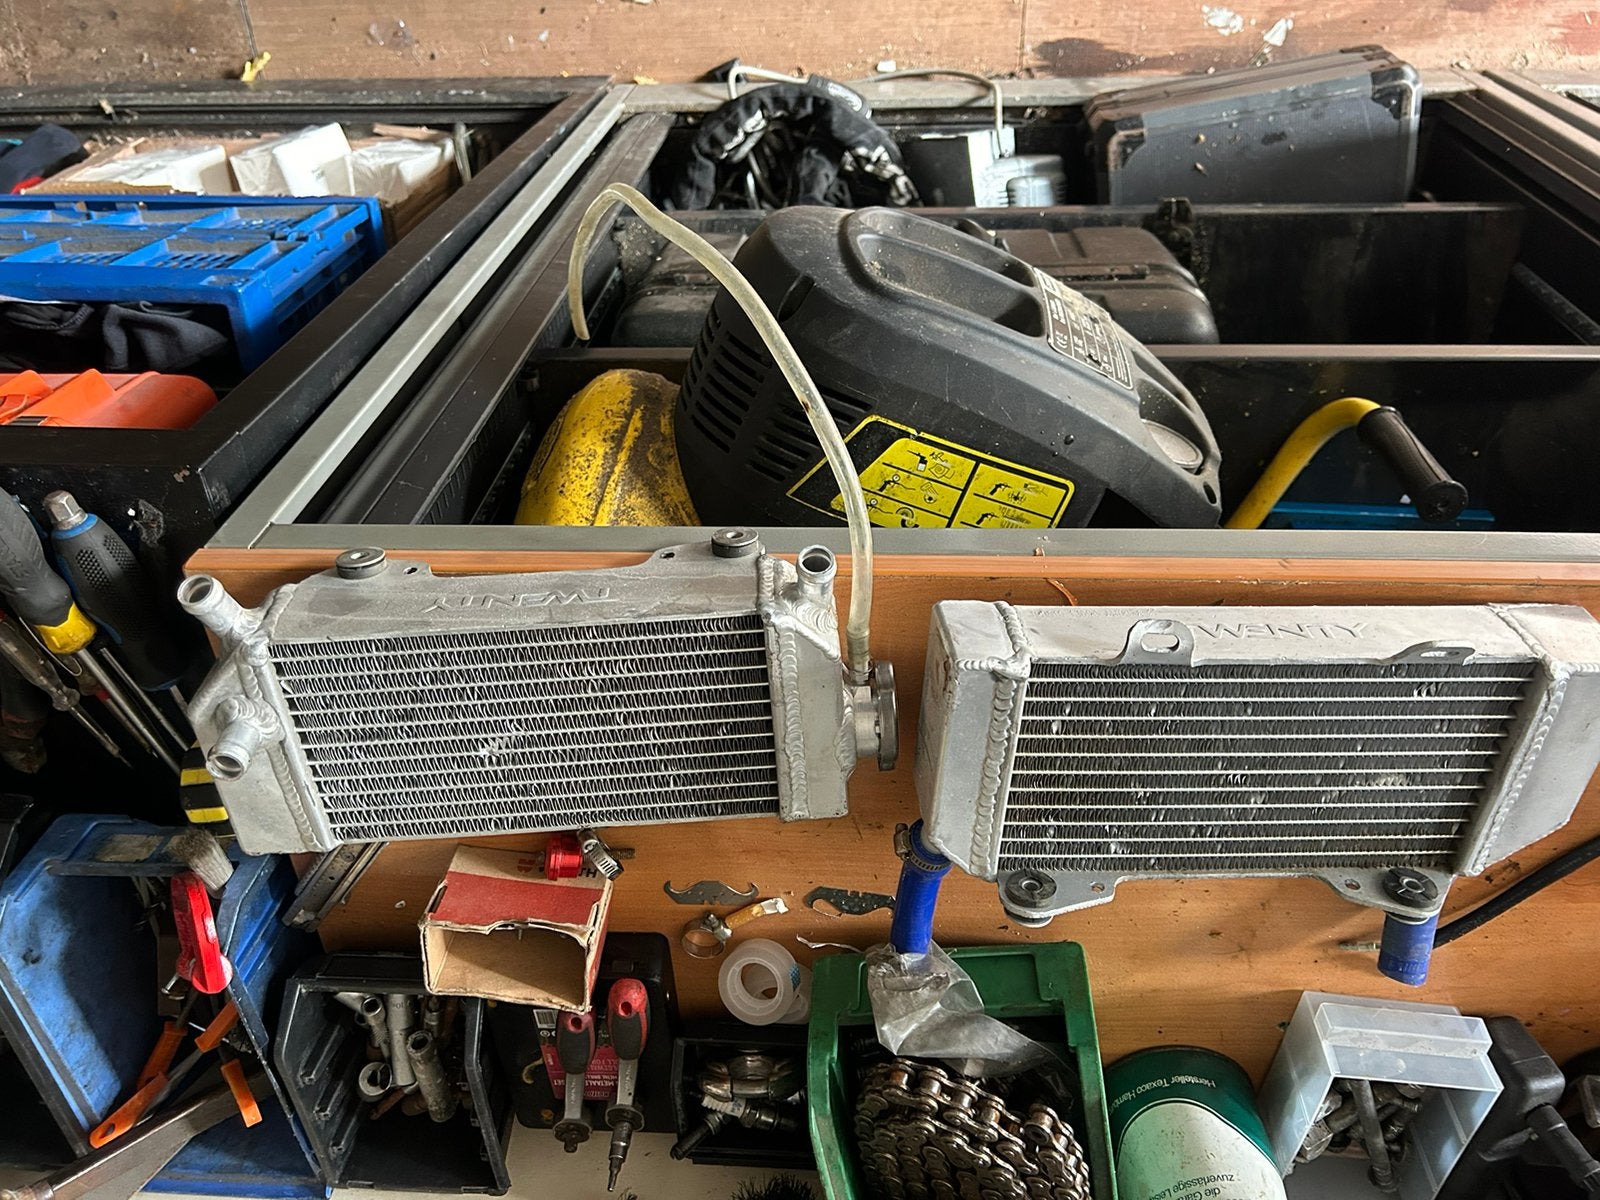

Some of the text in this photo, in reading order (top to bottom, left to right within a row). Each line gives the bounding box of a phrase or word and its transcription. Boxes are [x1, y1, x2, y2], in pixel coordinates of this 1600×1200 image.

[420, 587, 619, 613] TWENTY
[1136, 1078, 1170, 1094] Texaco
[1170, 1075, 1217, 1089] Hersteller
[1172, 1174, 1236, 1194] zuverlässige
[1204, 1187, 1221, 1198] die
